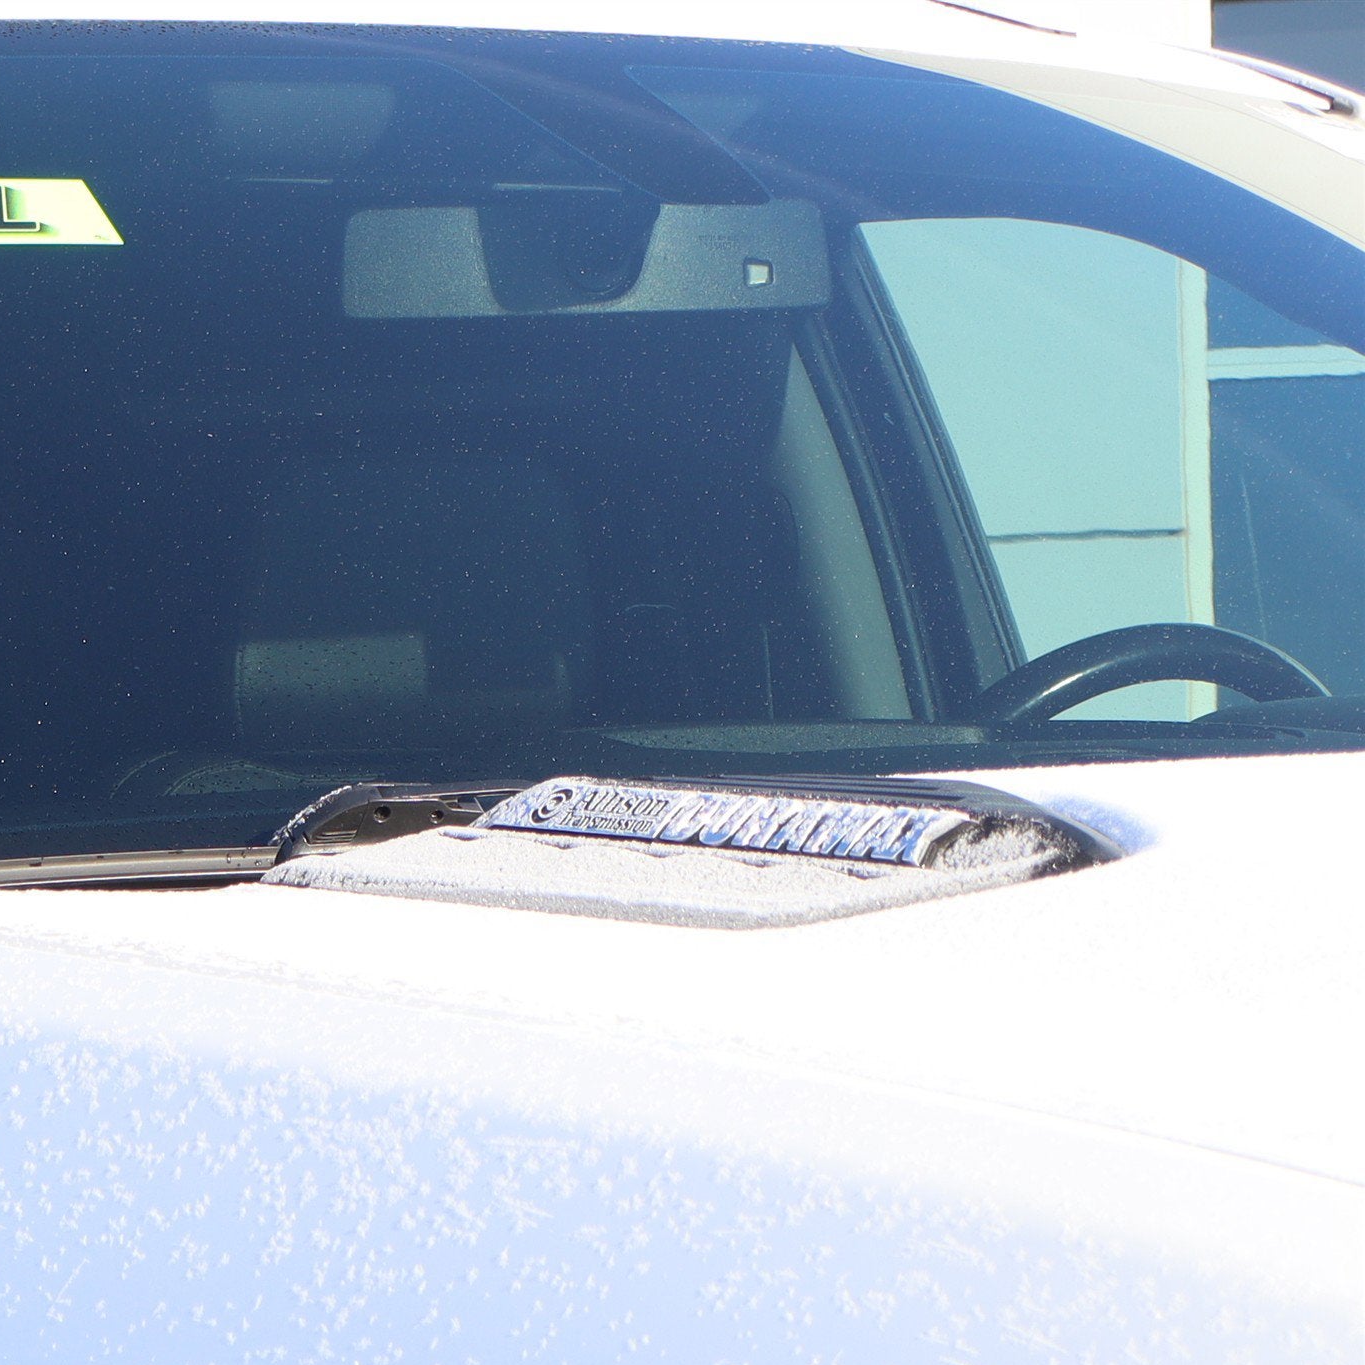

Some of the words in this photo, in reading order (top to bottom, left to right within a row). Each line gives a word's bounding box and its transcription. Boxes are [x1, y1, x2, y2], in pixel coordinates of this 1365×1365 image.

[571, 788, 670, 817] Allison
[558, 808, 655, 833] Transmission
[659, 791, 925, 863] DURAMAX
